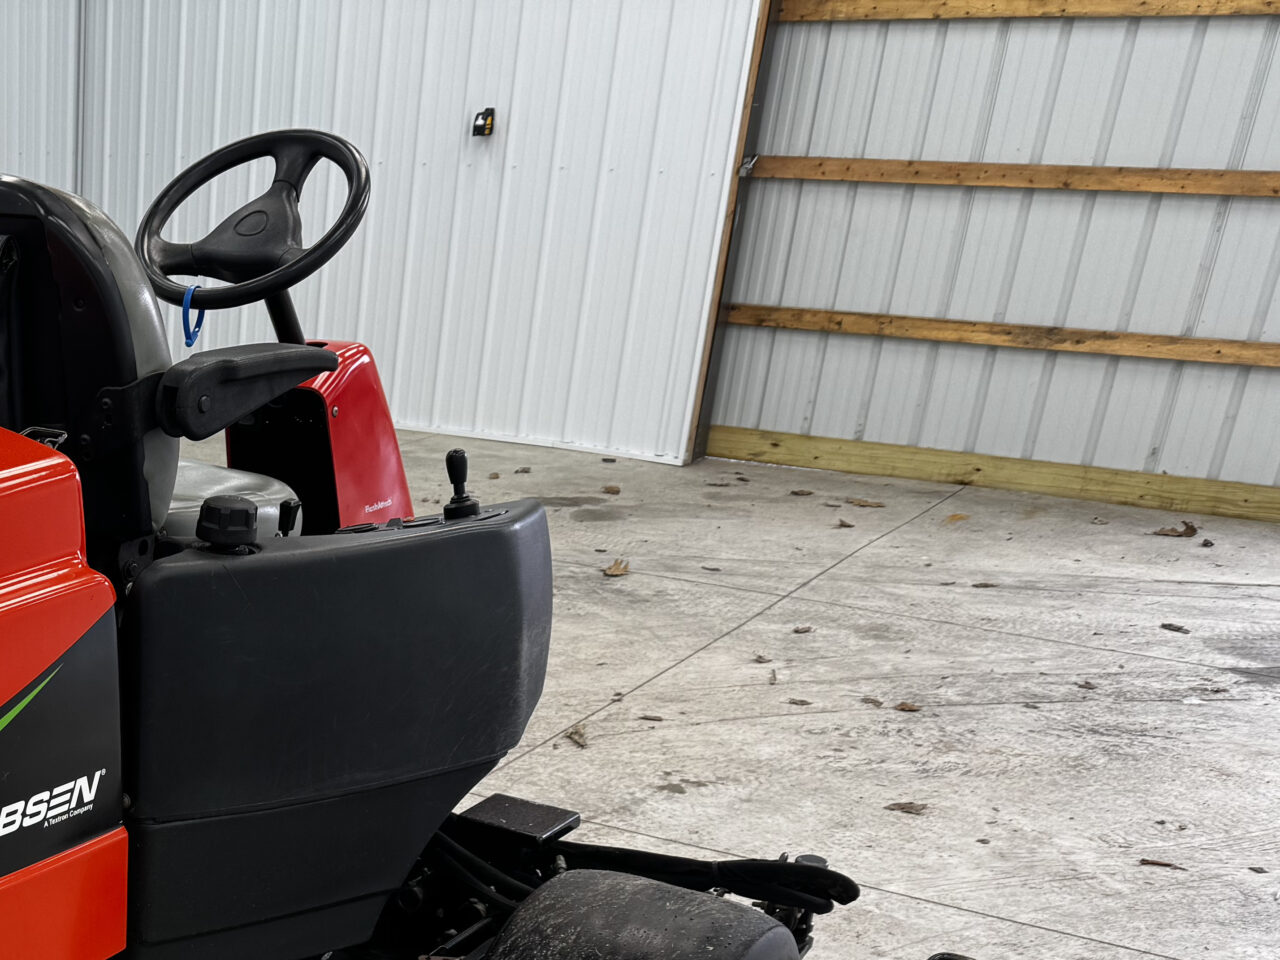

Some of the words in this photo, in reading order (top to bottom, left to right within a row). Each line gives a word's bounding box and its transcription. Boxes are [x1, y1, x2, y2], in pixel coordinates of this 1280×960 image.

[43, 820, 49, 829] A
[49, 813, 69, 826] Textron
[69, 803, 94, 818] Company
